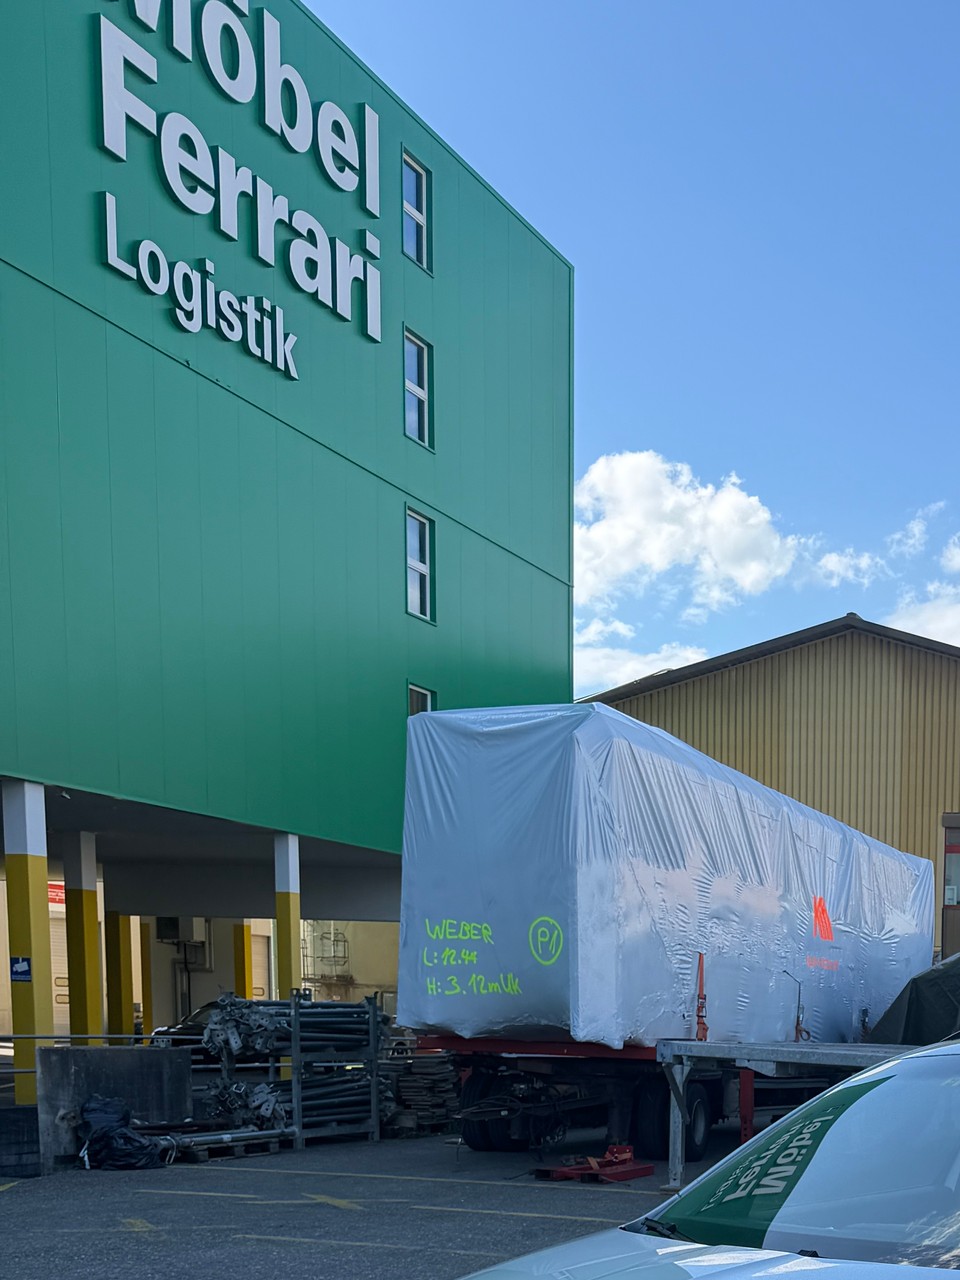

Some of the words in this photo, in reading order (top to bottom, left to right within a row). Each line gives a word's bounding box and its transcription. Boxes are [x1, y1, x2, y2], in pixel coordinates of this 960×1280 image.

[99, 14, 381, 342] Ferrari
[105, 191, 299, 380] Logistik
[425, 918, 495, 945] WEBER
